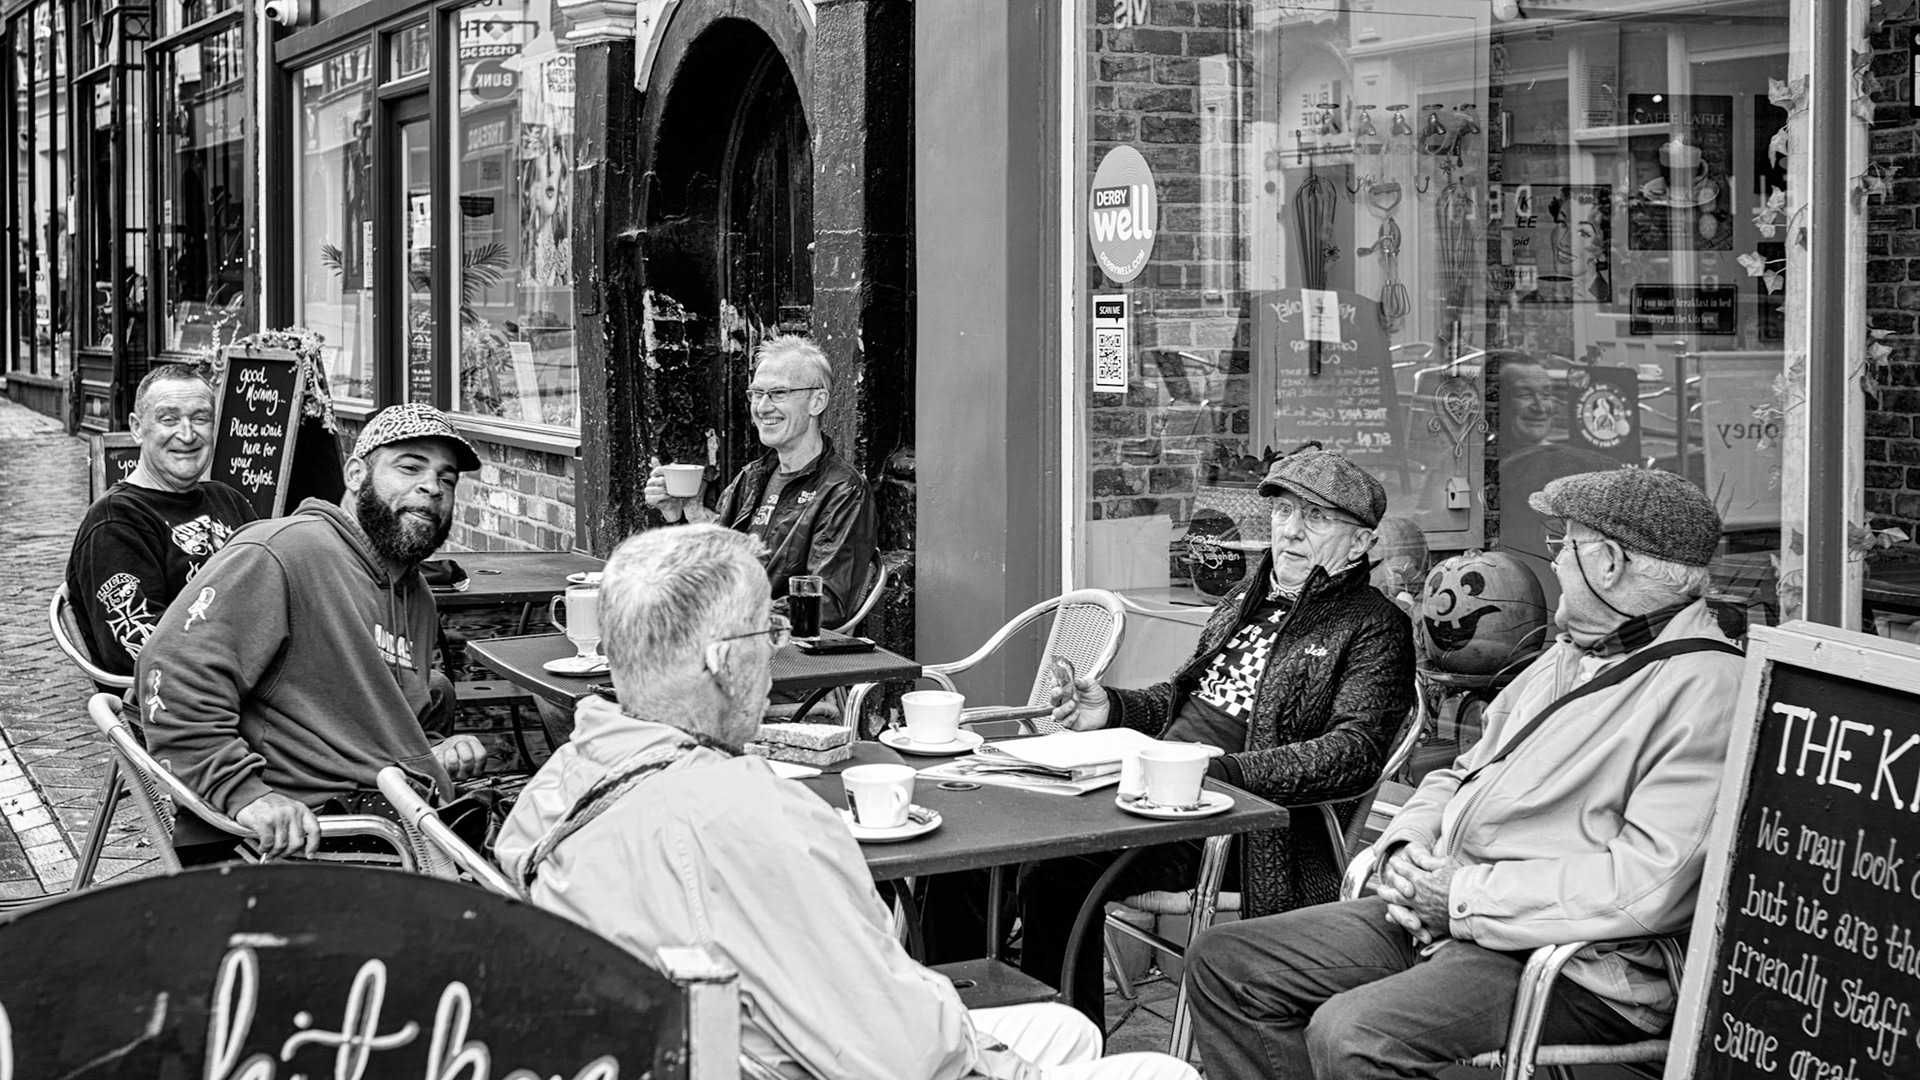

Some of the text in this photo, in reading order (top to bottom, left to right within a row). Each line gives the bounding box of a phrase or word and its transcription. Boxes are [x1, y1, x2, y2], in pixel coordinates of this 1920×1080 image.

[1096, 188, 1128, 207] DERBY
[1093, 184, 1152, 242] well
[1100, 249, 1146, 276] DERBYWELL.COM
[1099, 305, 1121, 315] SCAN ME
[1676, 297, 1709, 308] breakfast
[1711, 298, 1718, 308] in
[1719, 298, 1732, 308] bed
[236, 366, 268, 394] good
[230, 417, 283, 437] Please wait
[242, 440, 277, 457] here for
[230, 457, 252, 475] your
[242, 466, 276, 493] Stylist.
[1773, 702, 1875, 794] THE
[1757, 806, 1790, 856] We
[1796, 824, 1846, 895] may
[1851, 828, 1905, 893] look
[1740, 873, 1788, 926] but
[1795, 895, 1829, 940] we
[1834, 913, 1879, 960] are
[1722, 937, 1909, 1066] friendly staff
[1714, 1011, 1779, 1072] same
